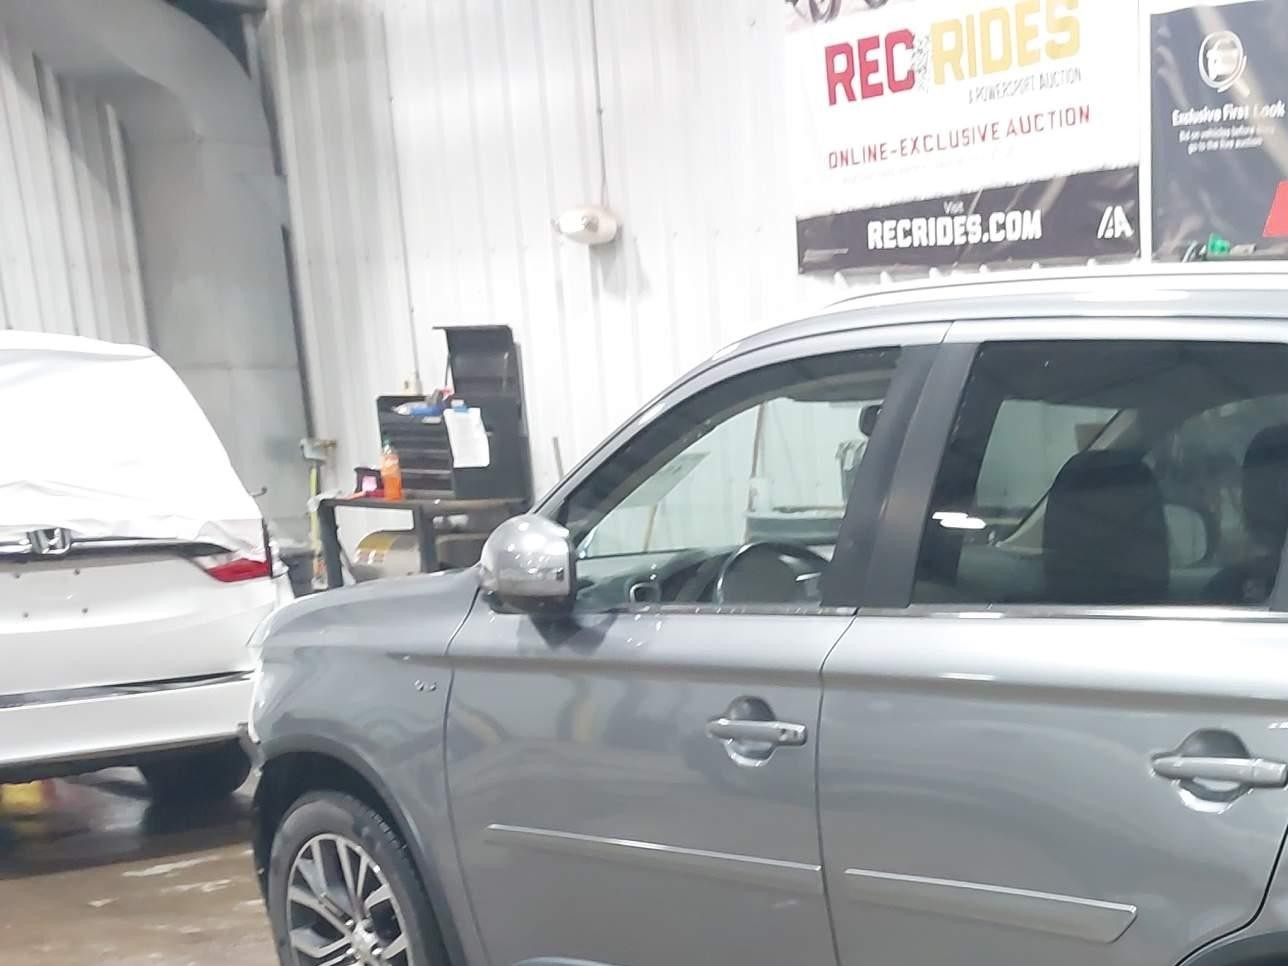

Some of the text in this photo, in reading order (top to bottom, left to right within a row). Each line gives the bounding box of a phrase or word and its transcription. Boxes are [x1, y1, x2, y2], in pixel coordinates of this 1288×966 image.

[1171, 105, 1222, 126] Exclusive
[1222, 103, 1250, 121] First
[828, 104, 1091, 170] ONLINE-EXCLUSIVE AUCTION
[867, 209, 1042, 250] RECRIDES.COM
